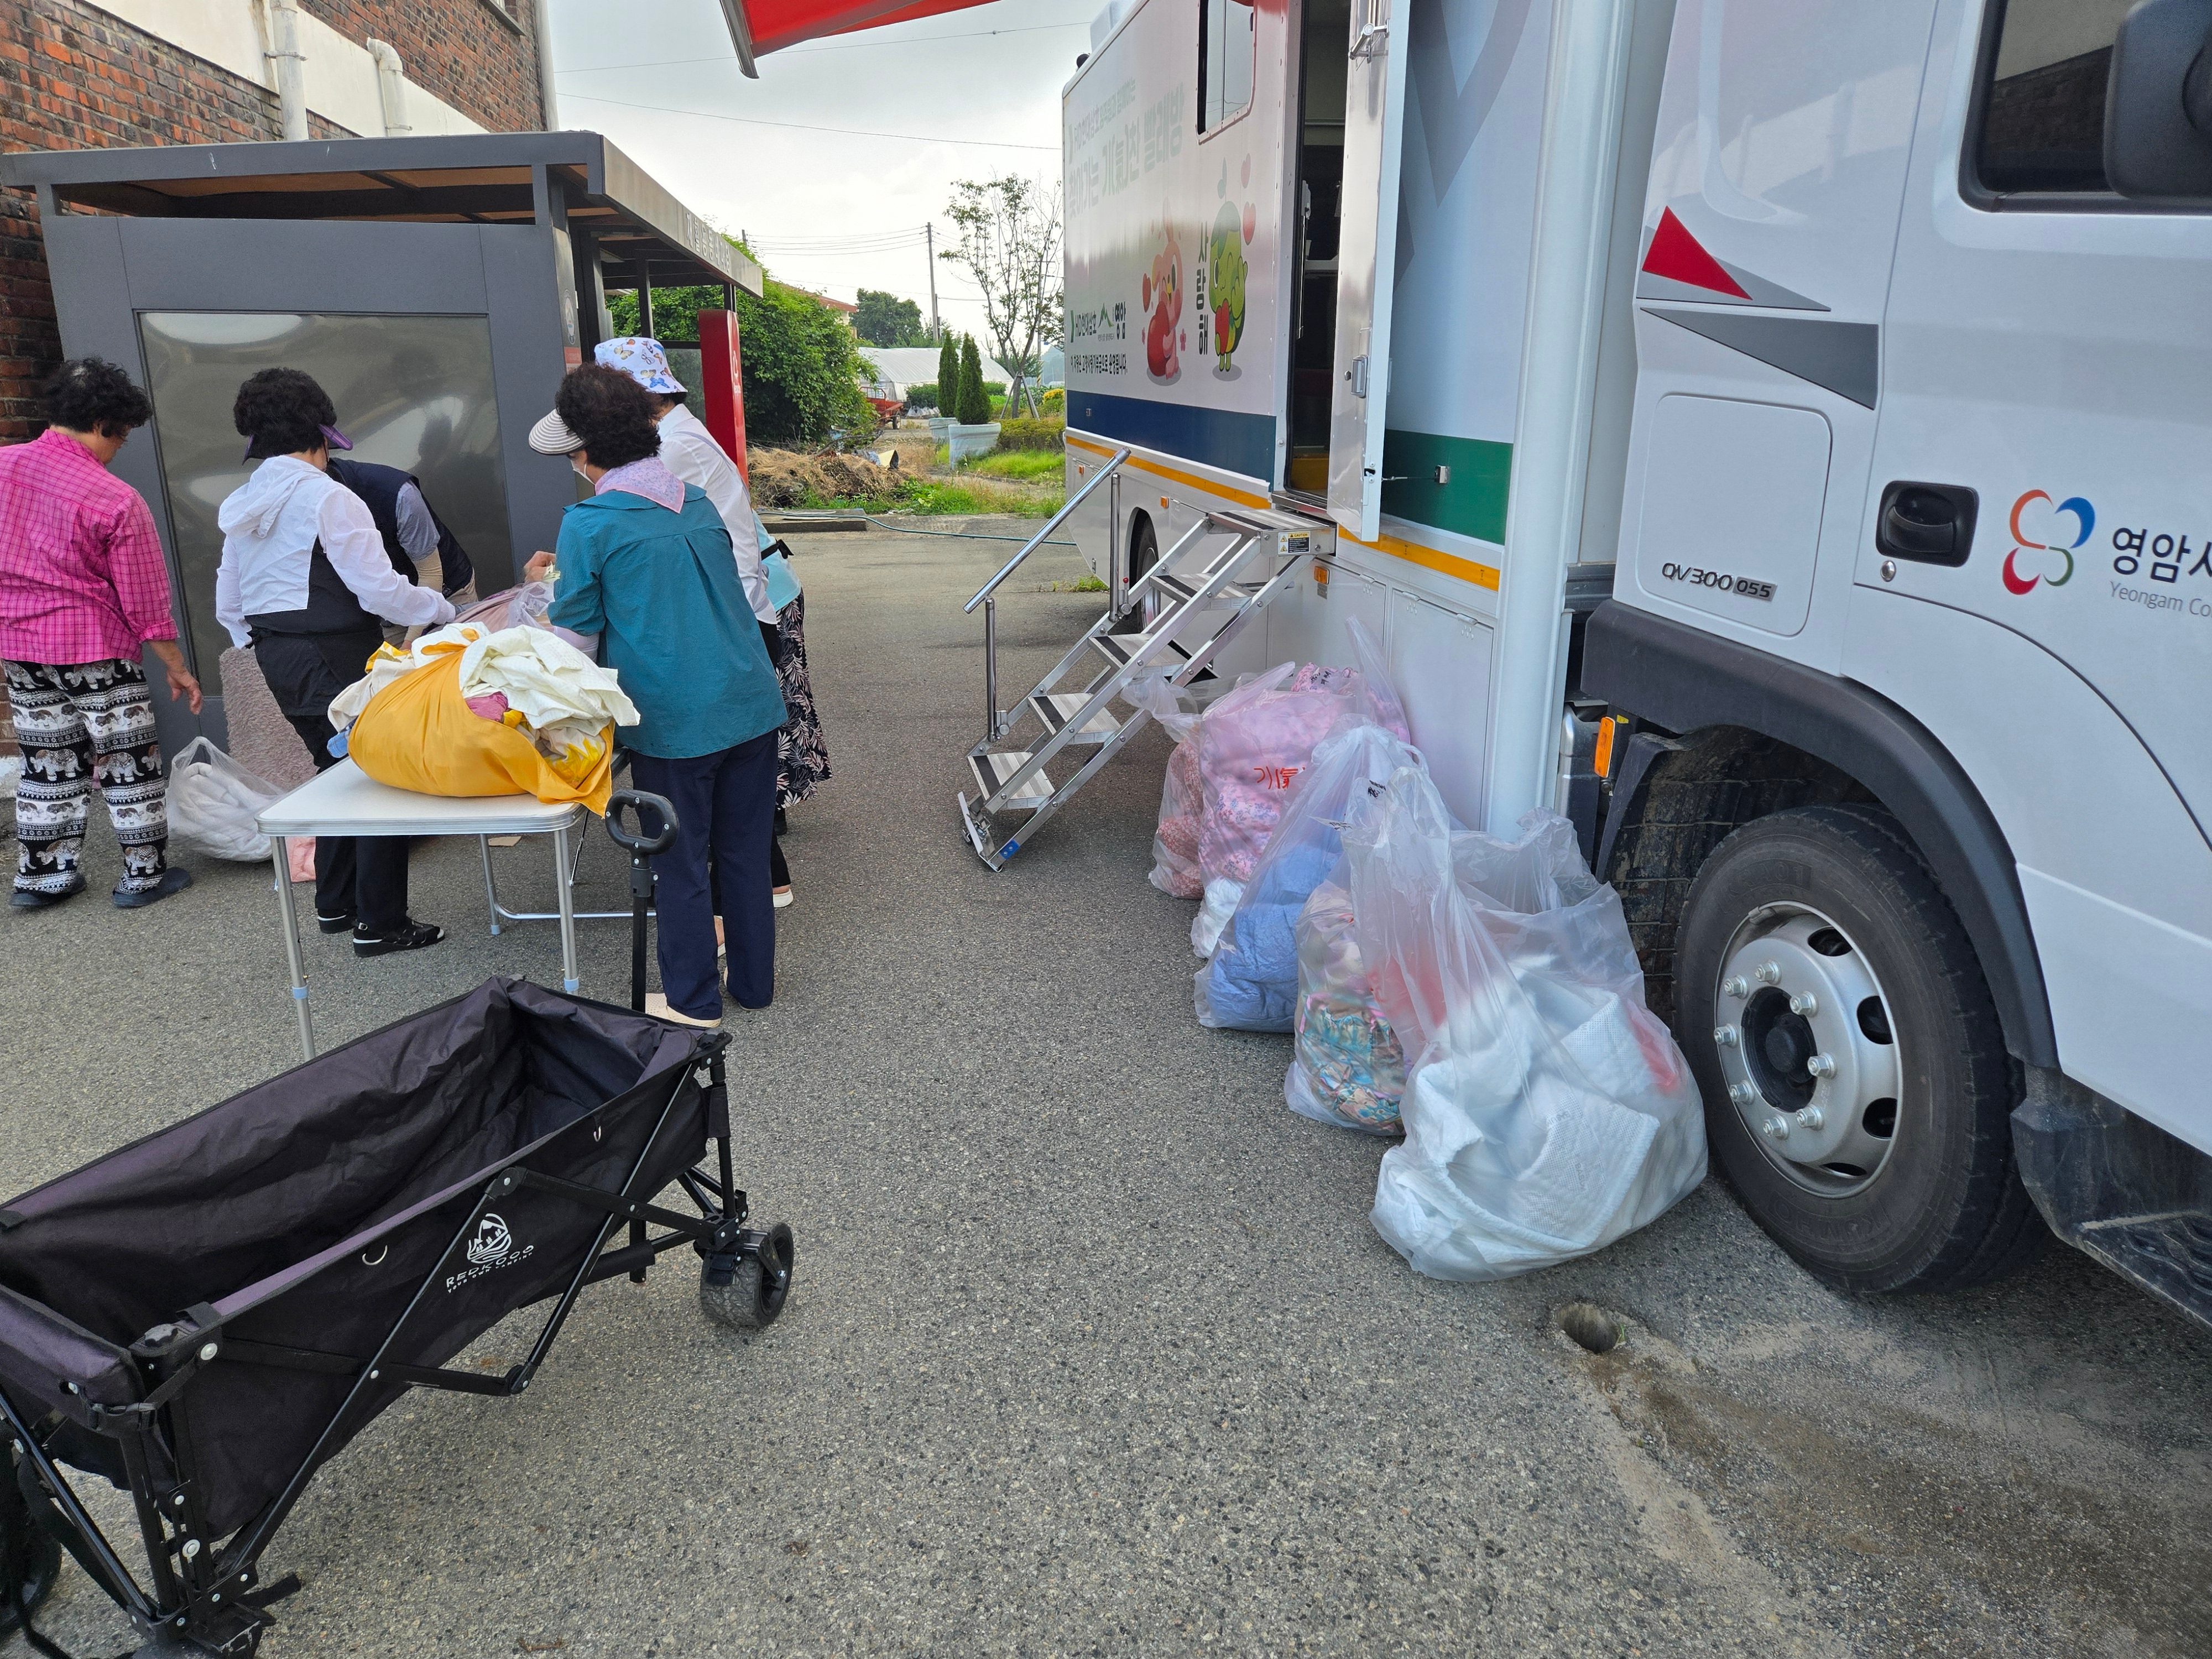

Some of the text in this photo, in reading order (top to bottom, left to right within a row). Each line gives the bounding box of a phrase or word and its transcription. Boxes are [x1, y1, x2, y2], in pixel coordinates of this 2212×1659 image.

[1069, 155, 1099, 220] 찾아가는
[1144, 82, 1185, 174] 빨래방
[1196, 221, 1209, 356] 사랑해
[1075, 310, 1097, 337] HD현대삼호
[1115, 301, 1126, 340] 영암
[1109, 353, 1128, 375] 운영됩니다.
[1662, 562, 1772, 598] QV300 055
[2110, 580, 2183, 612] Yeongam
[447, 1279, 468, 1293] YOUR
[472, 1269, 490, 1279] OWN
